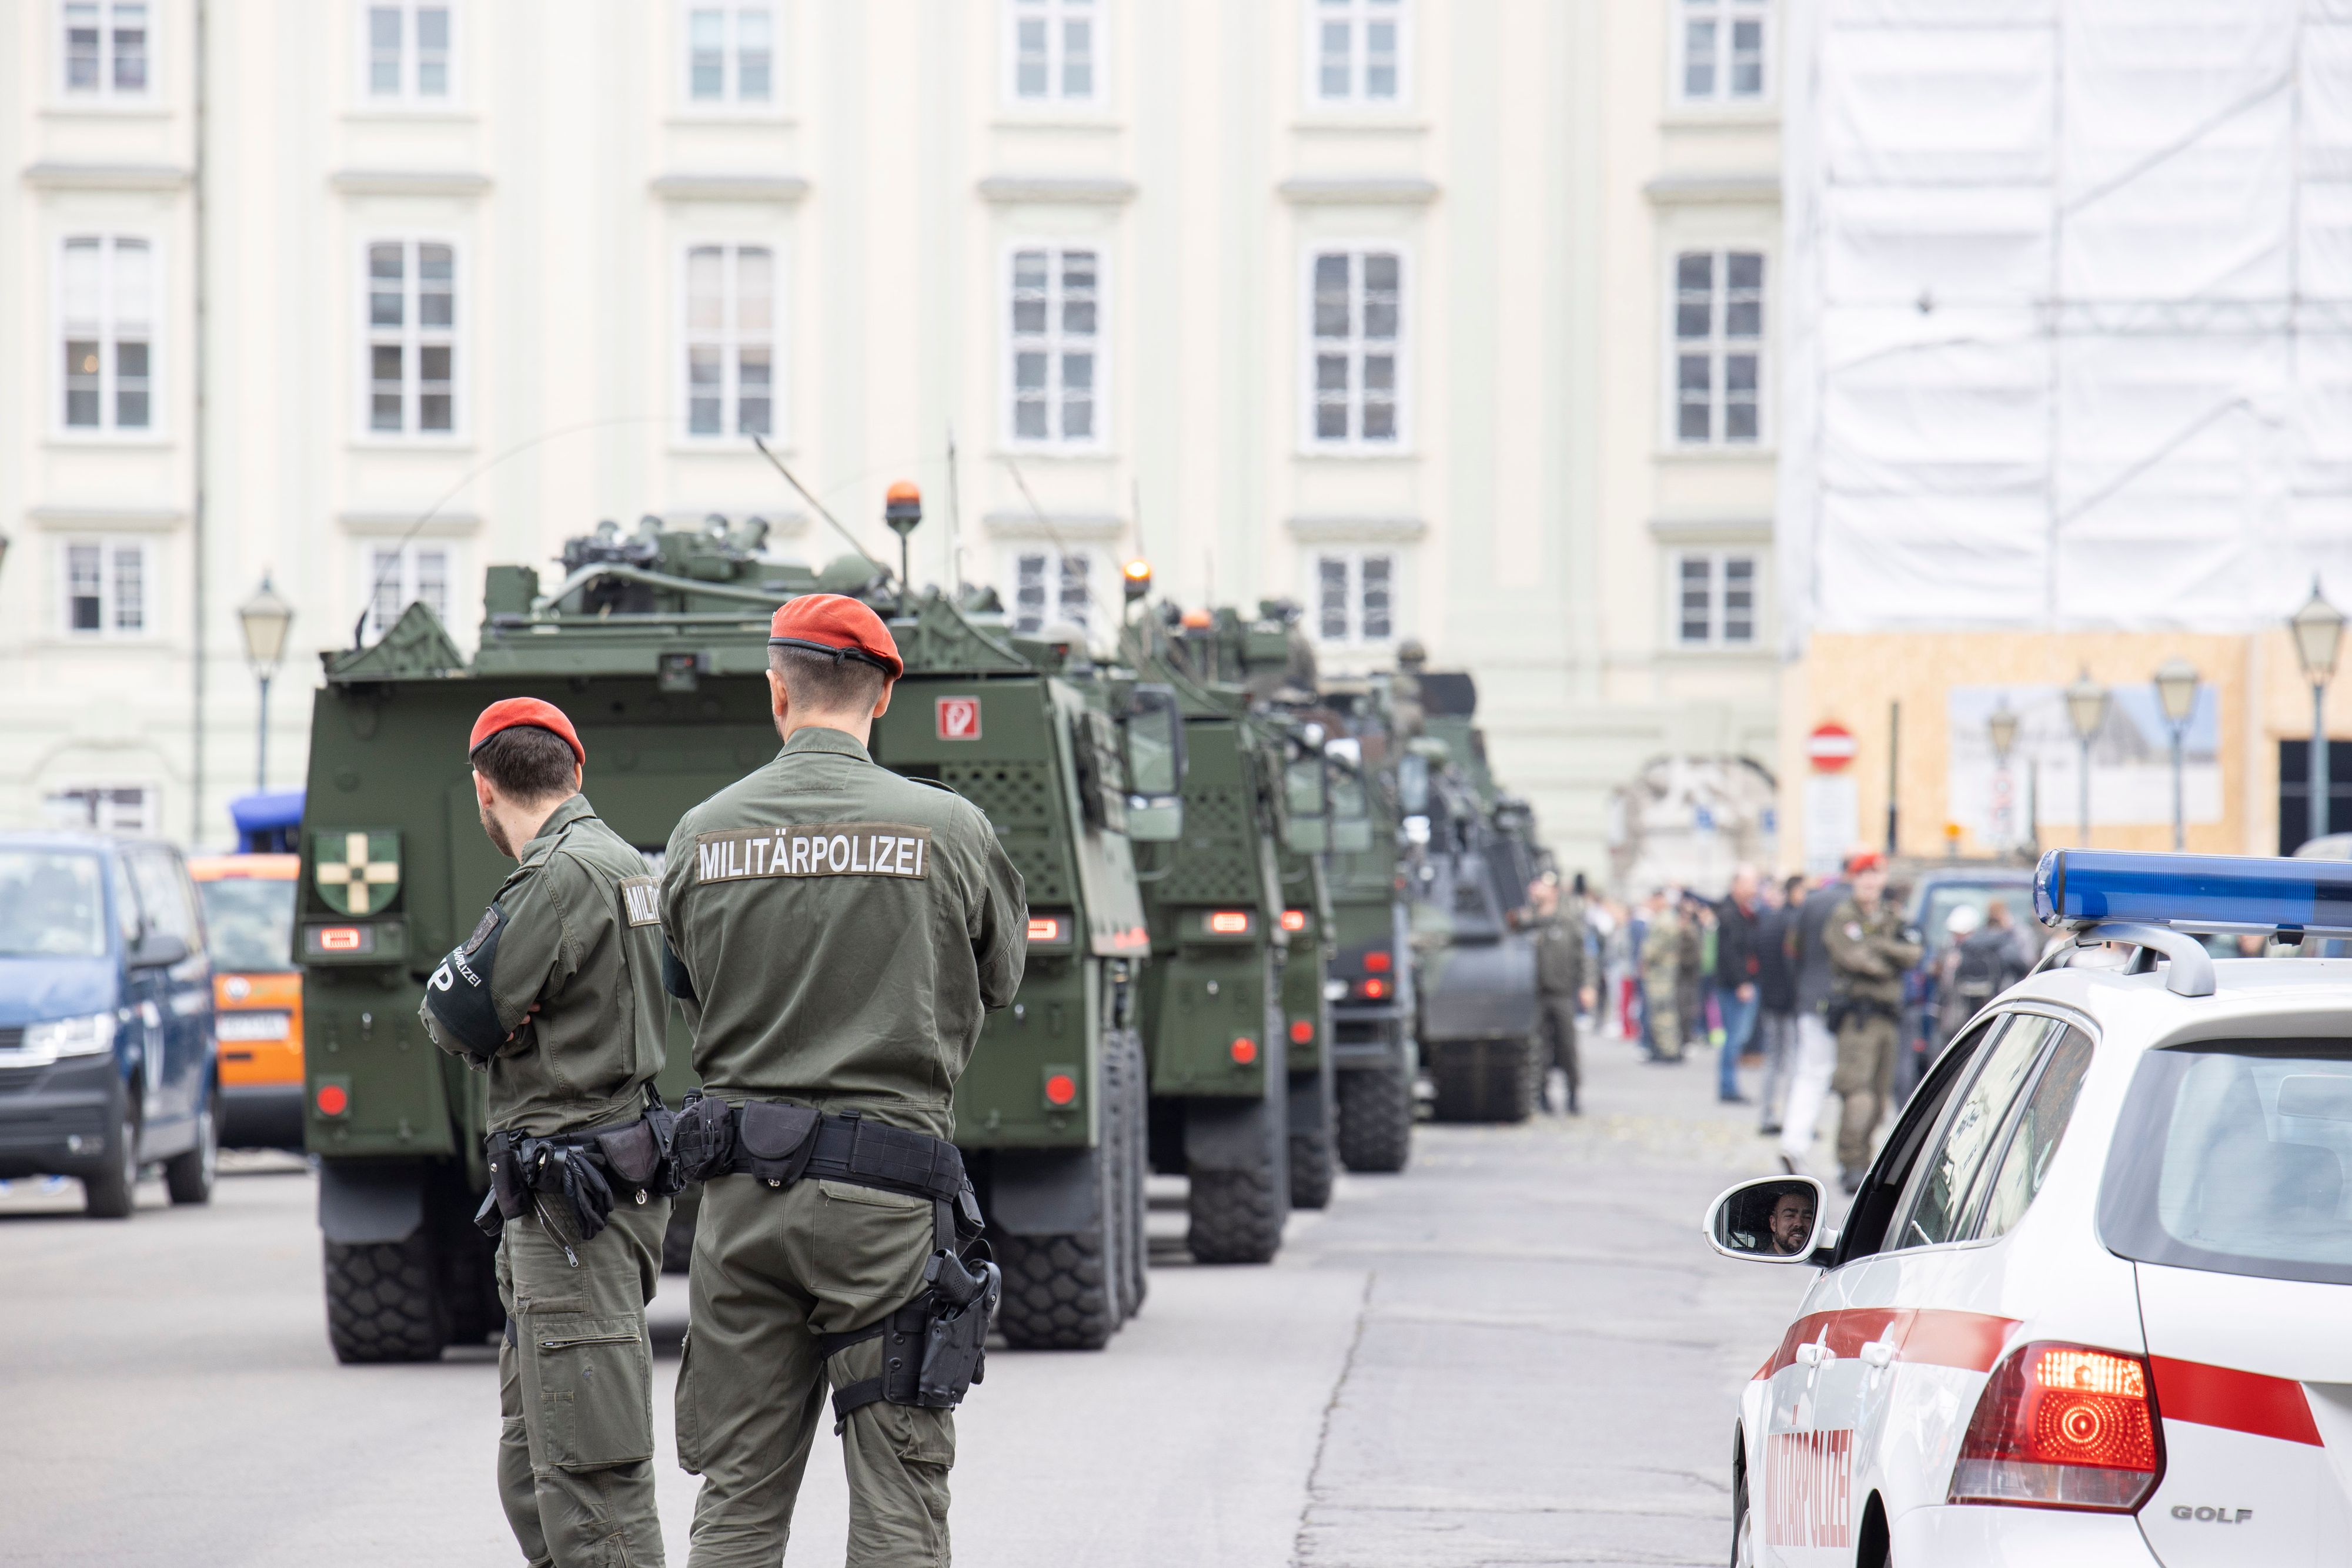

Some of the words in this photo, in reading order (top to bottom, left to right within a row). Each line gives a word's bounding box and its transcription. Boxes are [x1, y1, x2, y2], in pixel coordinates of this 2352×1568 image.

[700, 828, 924, 881] MILITÄRPOLIZEI
[1766, 1403, 1853, 1548] MILITÄRPOLIZEI
[2171, 1505, 2253, 1523] GOLF
